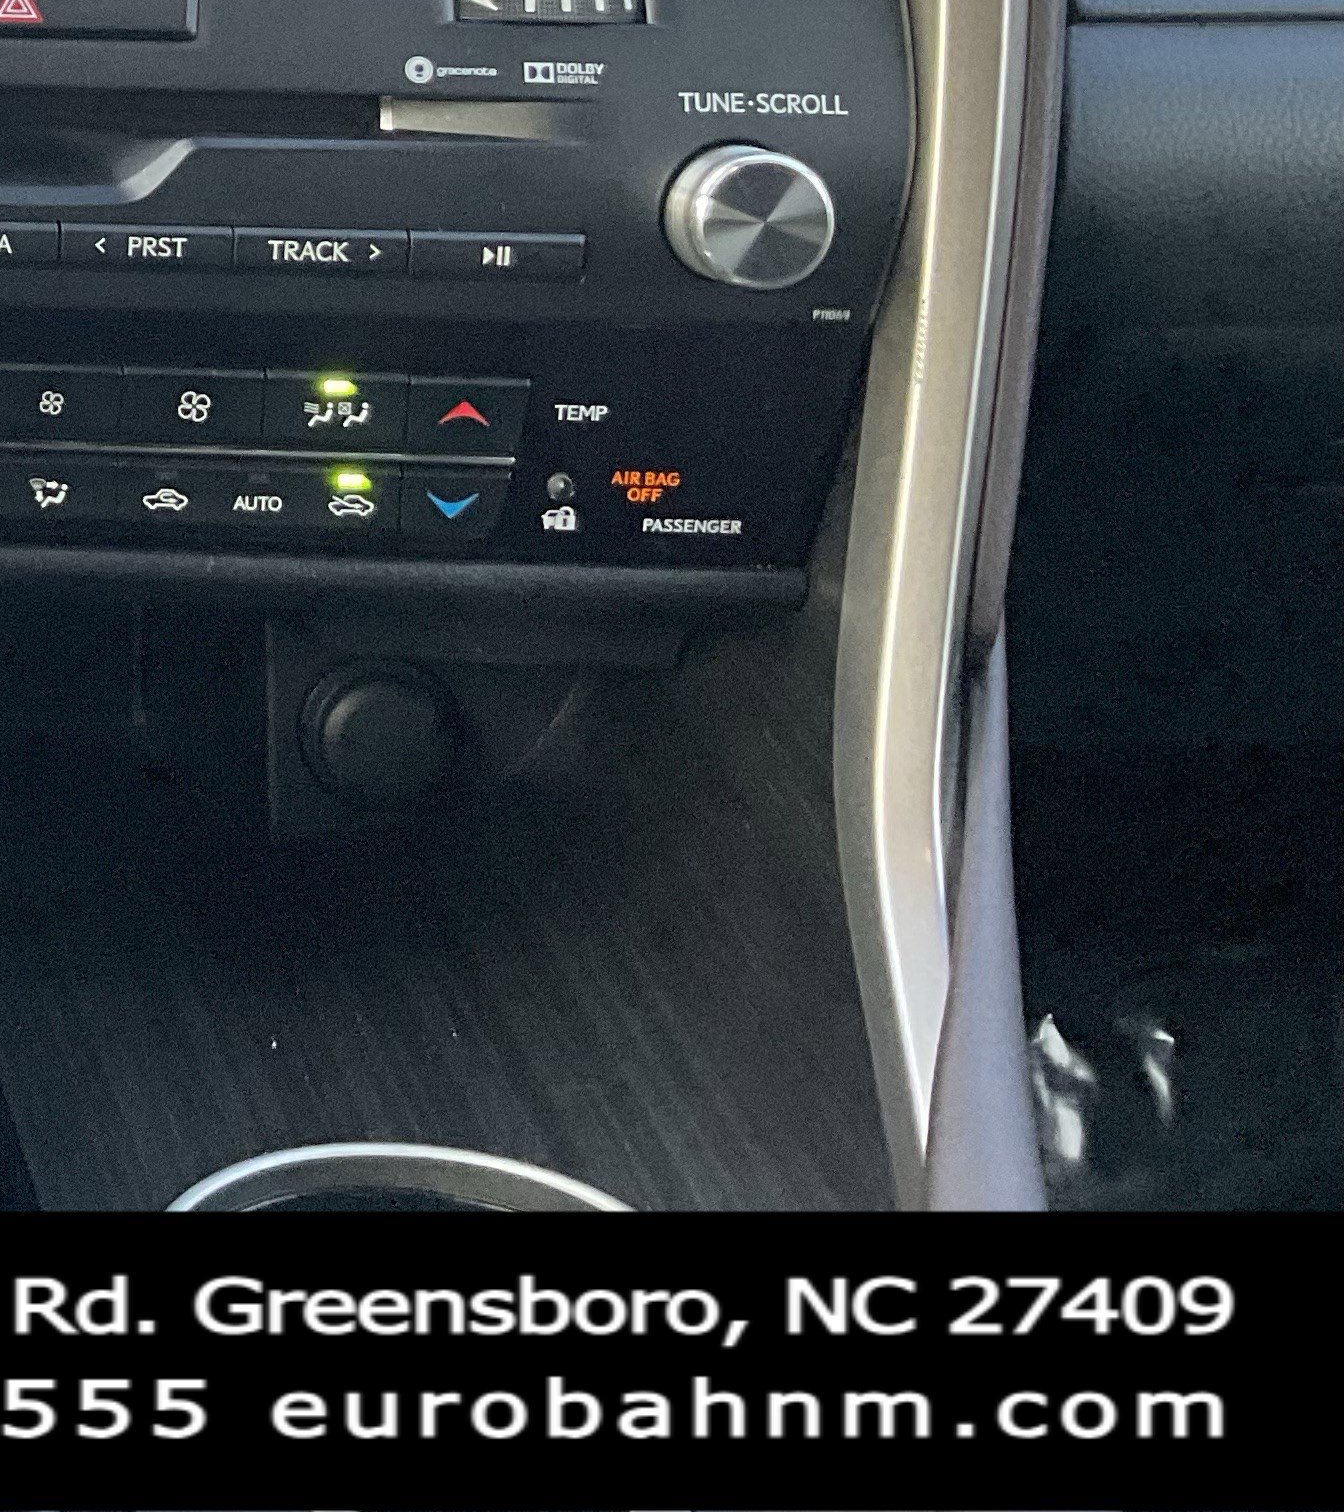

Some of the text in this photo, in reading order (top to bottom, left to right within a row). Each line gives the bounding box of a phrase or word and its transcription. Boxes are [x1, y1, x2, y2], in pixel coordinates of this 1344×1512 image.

[556, 62, 604, 75] DOLBY
[127, 236, 188, 258] PRST
[267, 239, 349, 262] TRACK
[554, 404, 608, 422] TEMP
[611, 470, 681, 487] AIR BAG
[626, 487, 664, 503] OFF
[232, 495, 283, 513] AUTO
[642, 518, 742, 535] PASSENGER
